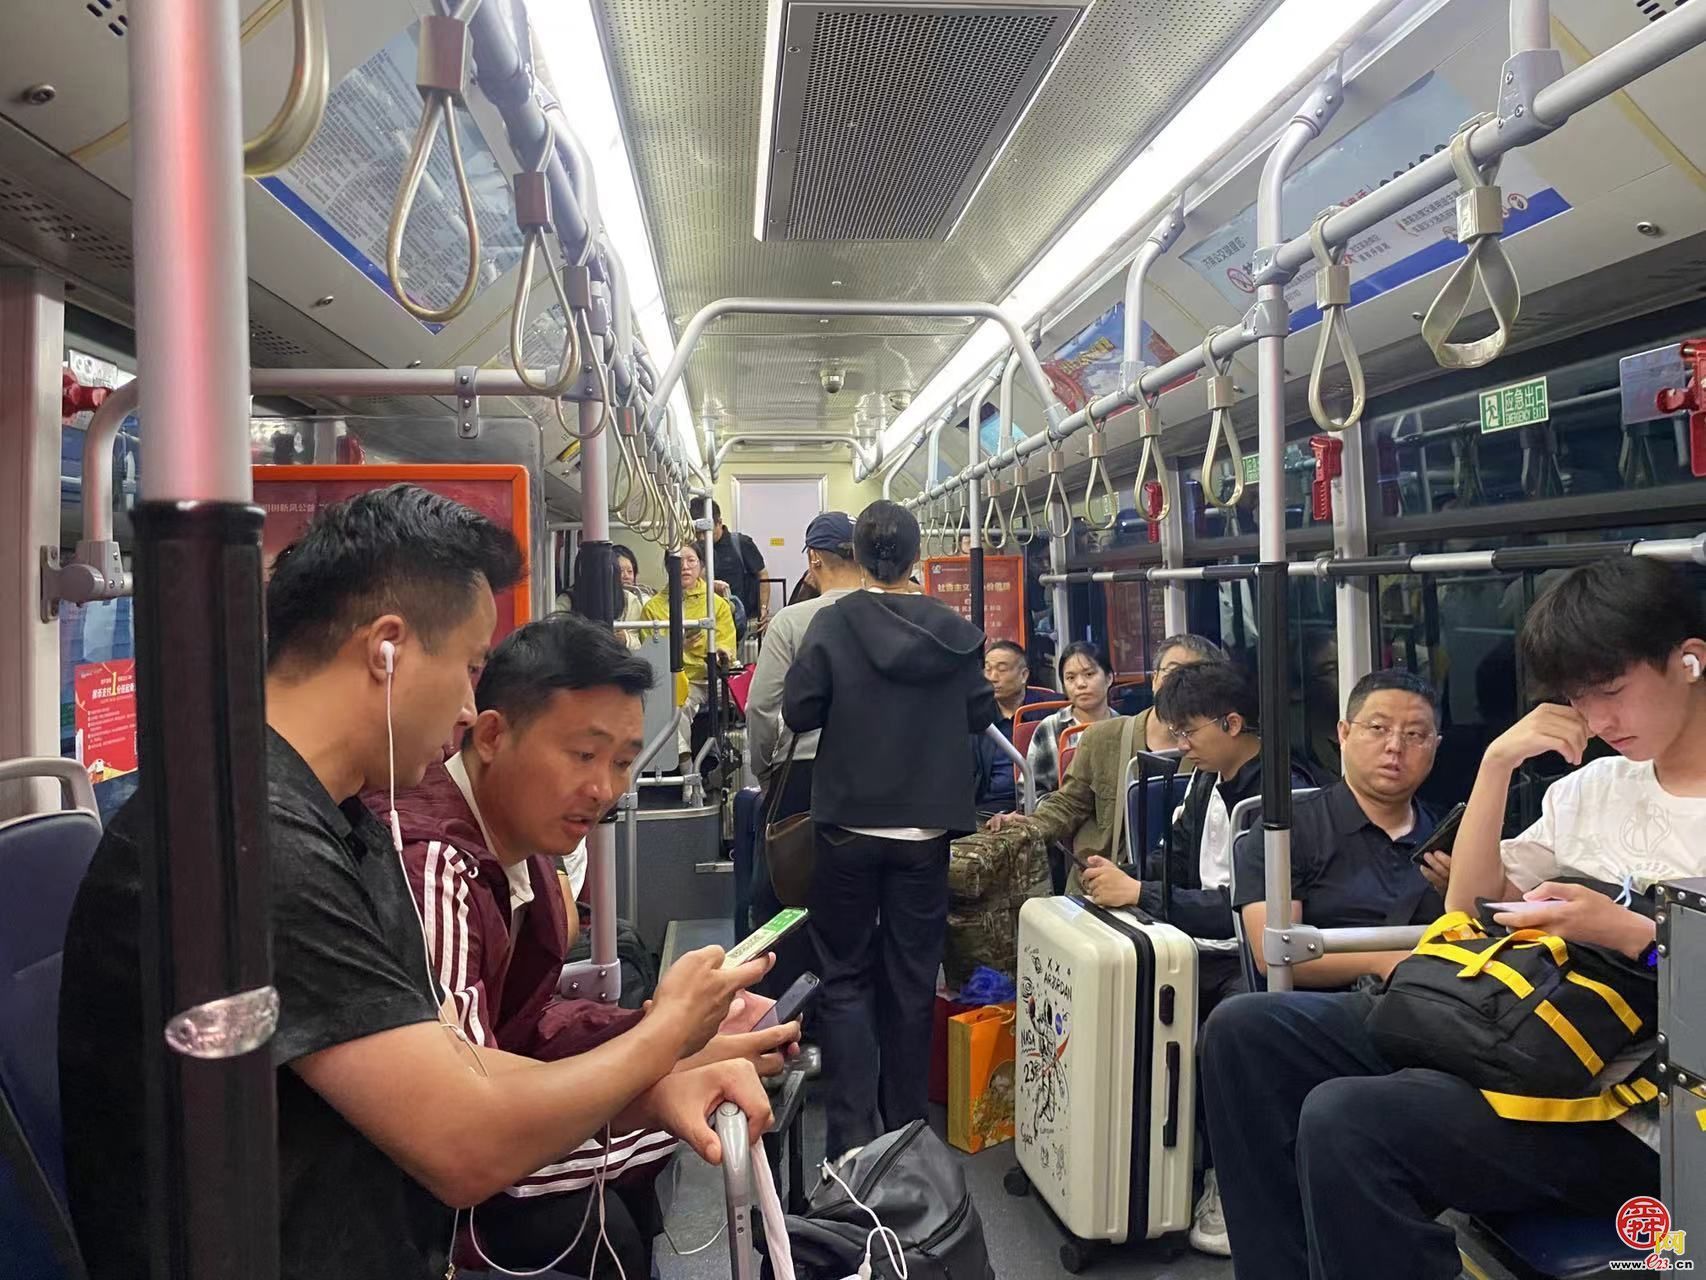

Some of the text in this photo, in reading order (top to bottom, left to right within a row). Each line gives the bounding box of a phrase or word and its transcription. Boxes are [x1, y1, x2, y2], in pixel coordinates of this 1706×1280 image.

[1505, 385, 1544, 413] 应急出口
[937, 582, 1011, 593] 社会主义价值观
[1020, 1029, 1036, 1048] NASA
[1023, 1060, 1035, 1083] 23
